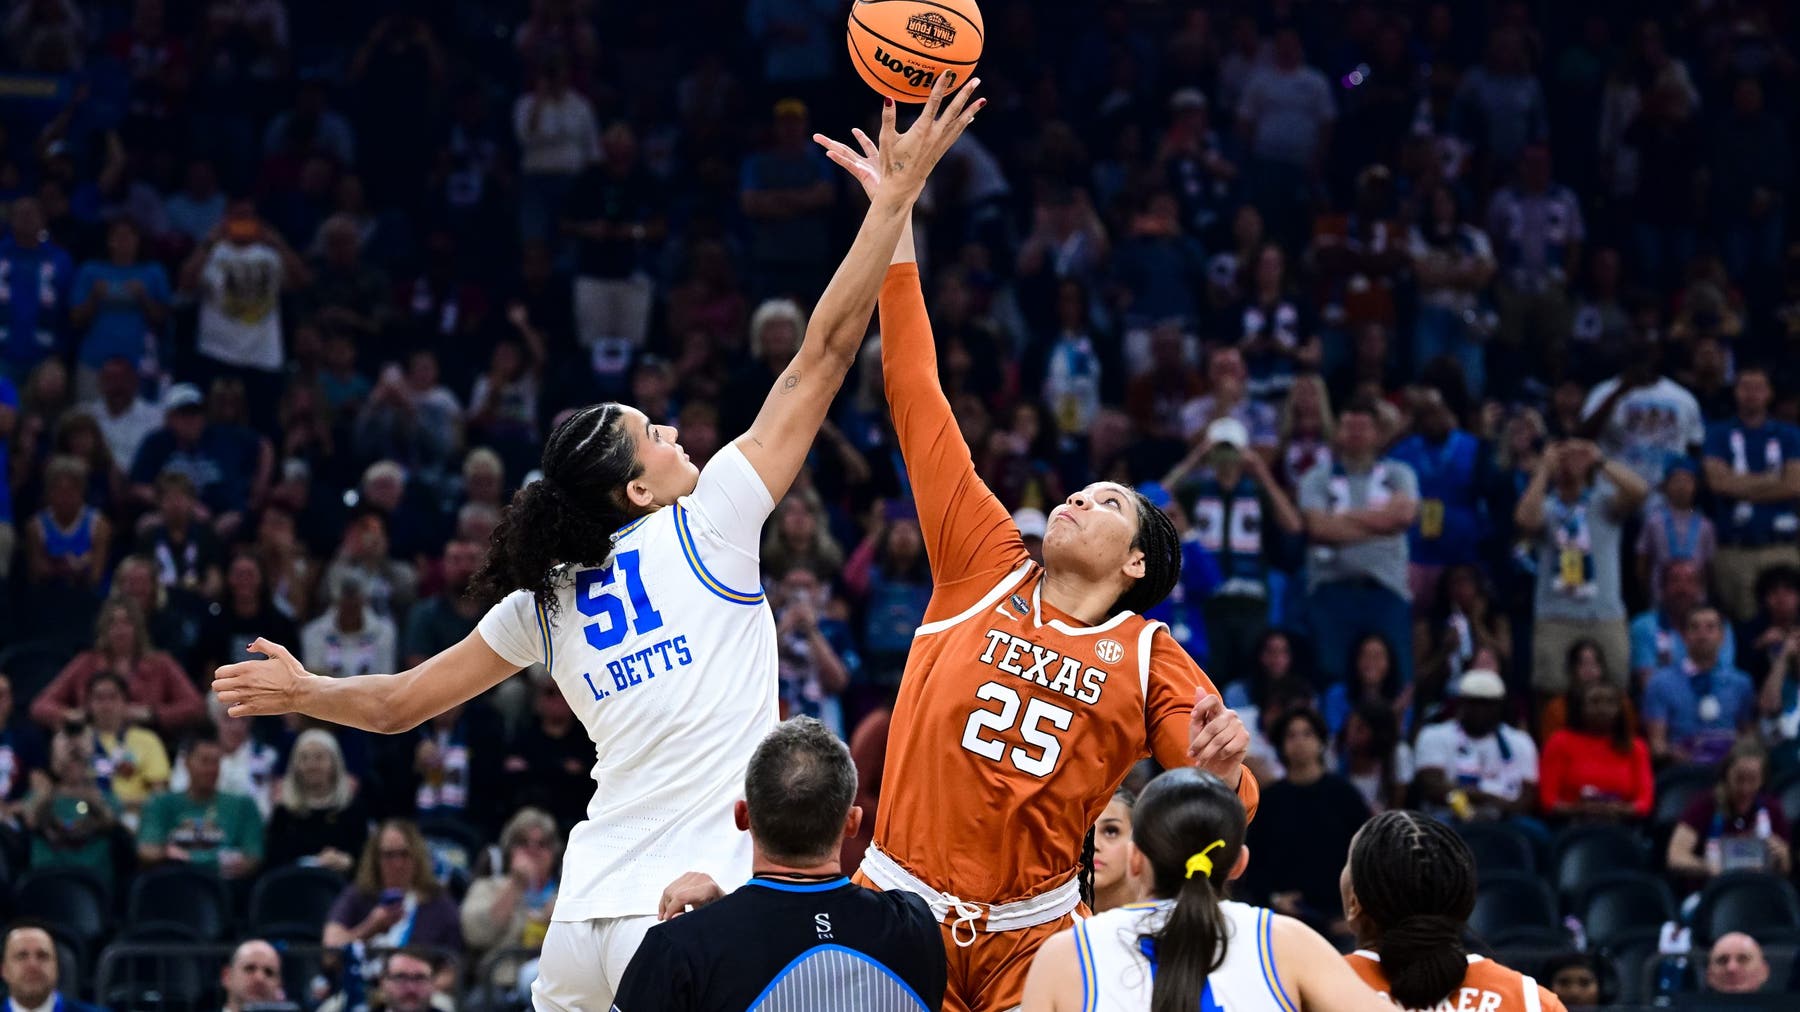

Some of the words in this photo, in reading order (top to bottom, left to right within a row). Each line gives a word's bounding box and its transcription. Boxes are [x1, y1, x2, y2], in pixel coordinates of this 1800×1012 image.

[909, 20, 932, 35] FOUR
[933, 27, 954, 42] FINAL
[575, 548, 664, 651] 51
[583, 672, 611, 701] L.
[606, 634, 693, 692] BETTS
[979, 628, 1108, 705] TEXAS
[1096, 639, 1122, 662] SEC
[961, 681, 1074, 778] 25
